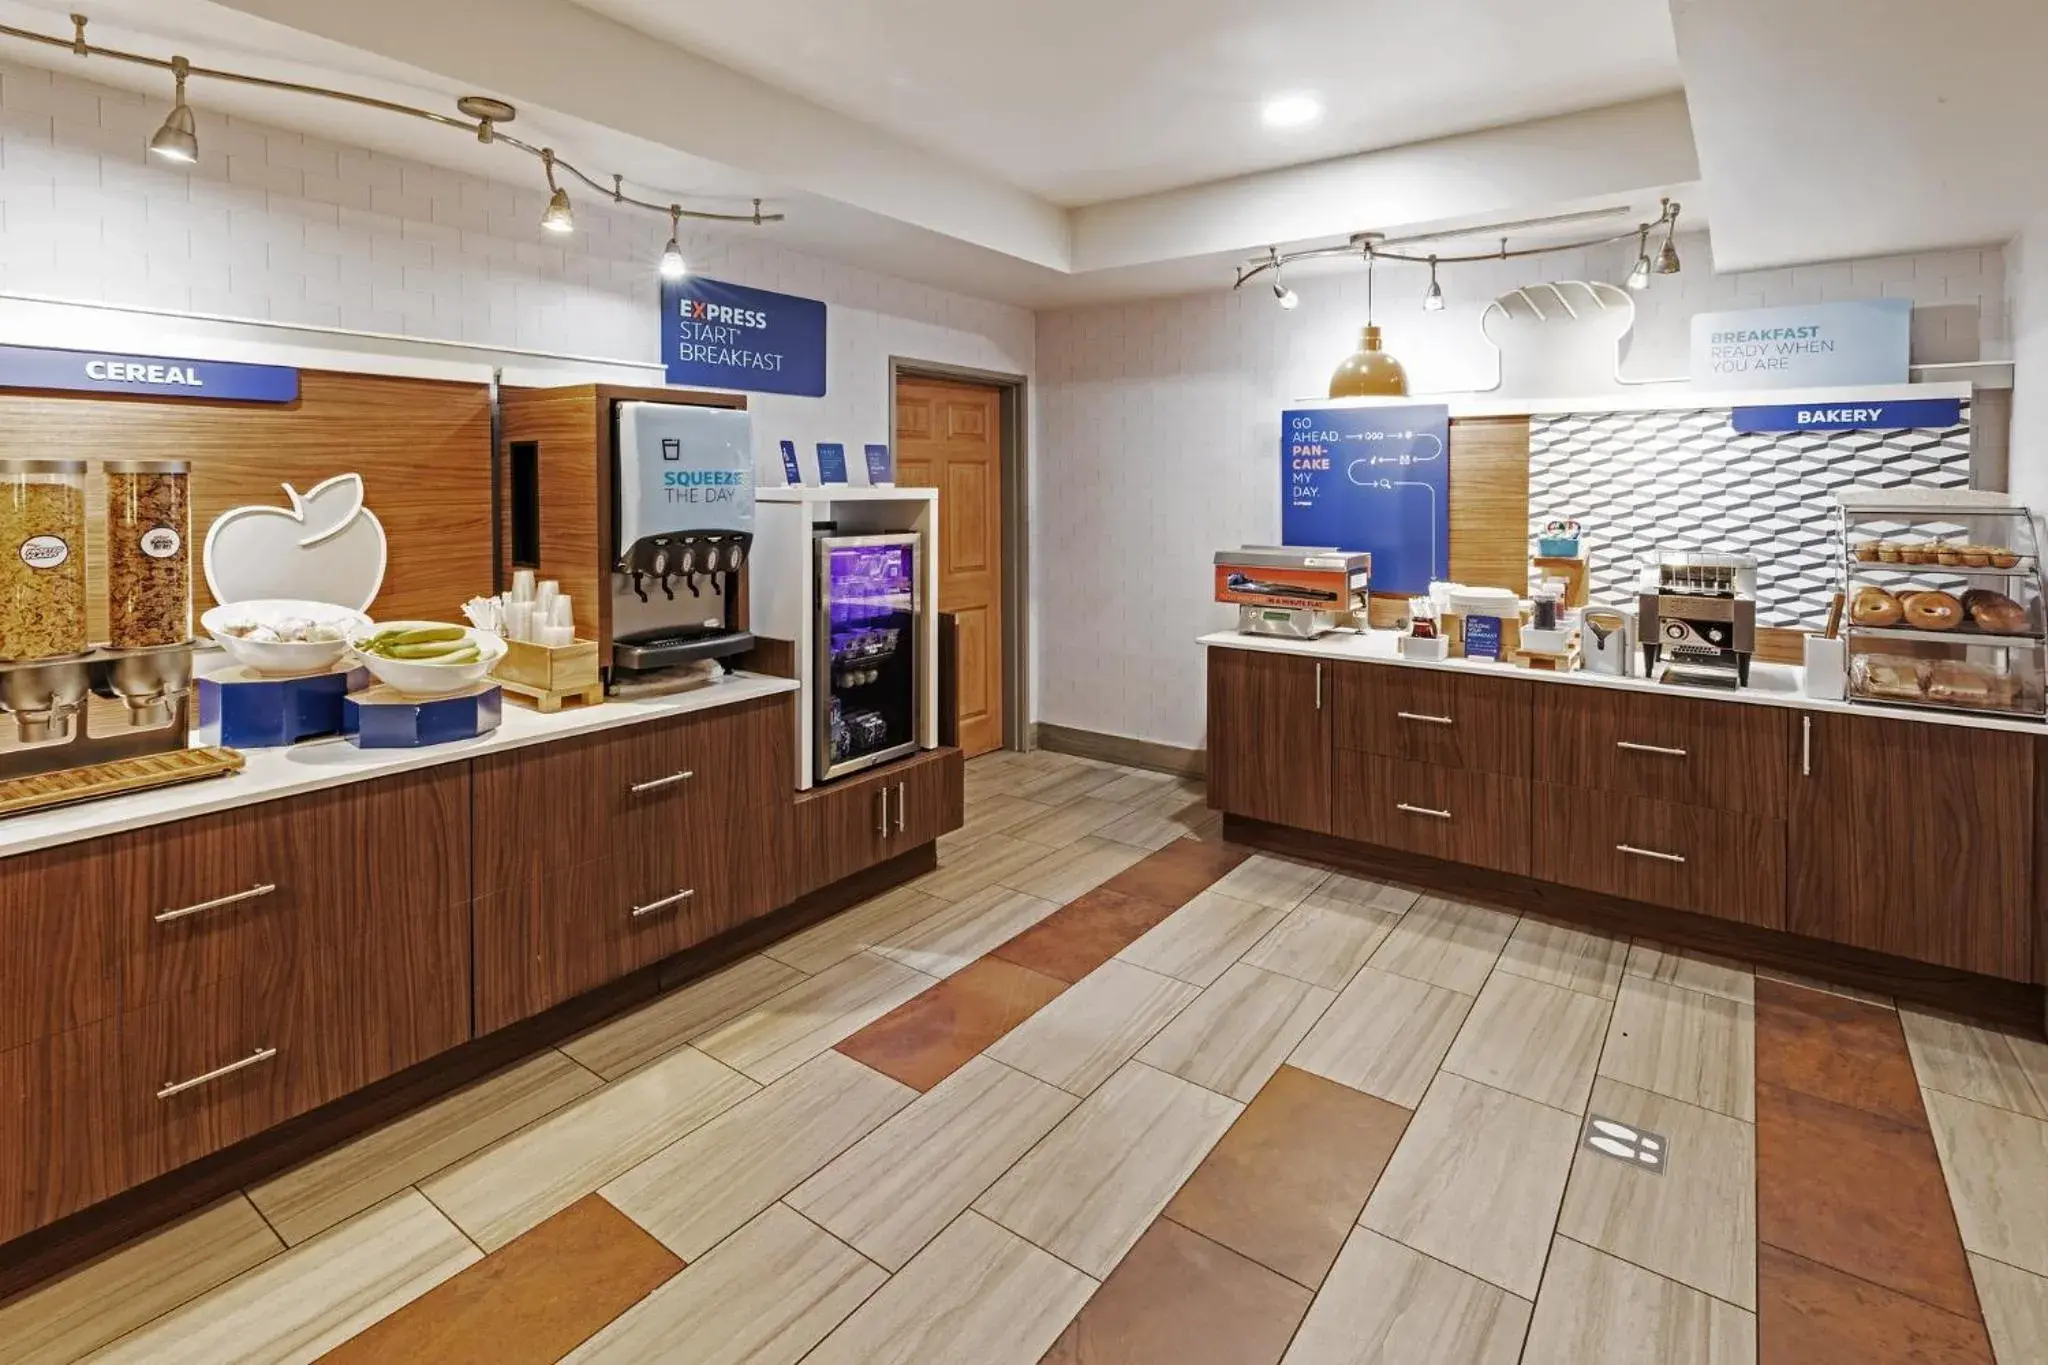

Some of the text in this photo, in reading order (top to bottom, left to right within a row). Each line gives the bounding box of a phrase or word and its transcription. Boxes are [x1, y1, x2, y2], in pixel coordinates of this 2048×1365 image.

[680, 299, 767, 329] EXPRESS
[1711, 325, 1820, 344] BREAKFAST
[680, 342, 784, 372] BREAKFAST
[1711, 339, 1835, 359] READY WHEN
[86, 360, 203, 386] CEREAL
[1712, 357, 1790, 373] YOU ARE
[1292, 417, 1312, 429] GO
[1797, 408, 1883, 424] BAKERY
[1292, 445, 1329, 456] PAN-
[1292, 458, 1331, 470] CAKE
[664, 471, 743, 487] SQUEEZE
[1292, 472, 1313, 484] MY
[664, 487, 736, 504] THE DAY
